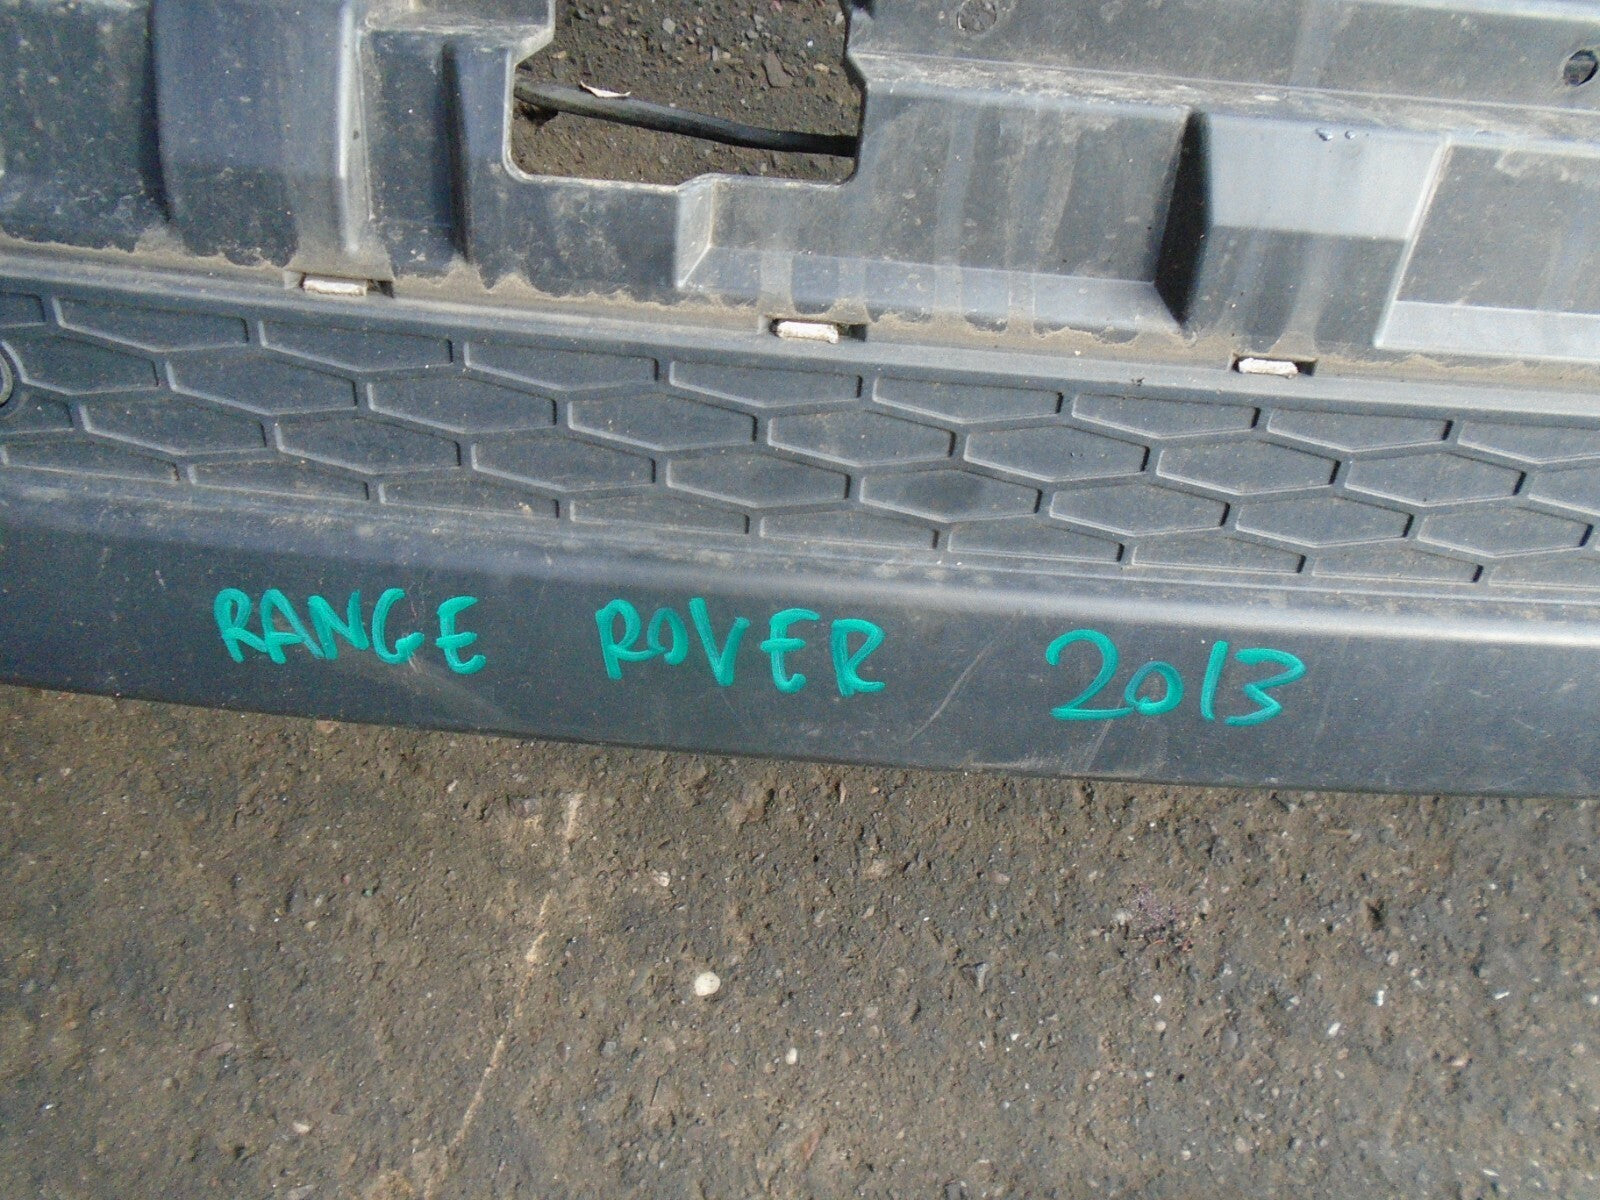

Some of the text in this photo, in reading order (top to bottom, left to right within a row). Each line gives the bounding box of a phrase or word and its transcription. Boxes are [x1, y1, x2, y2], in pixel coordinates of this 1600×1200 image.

[212, 586, 1307, 727] RANGE ROVER 2013
